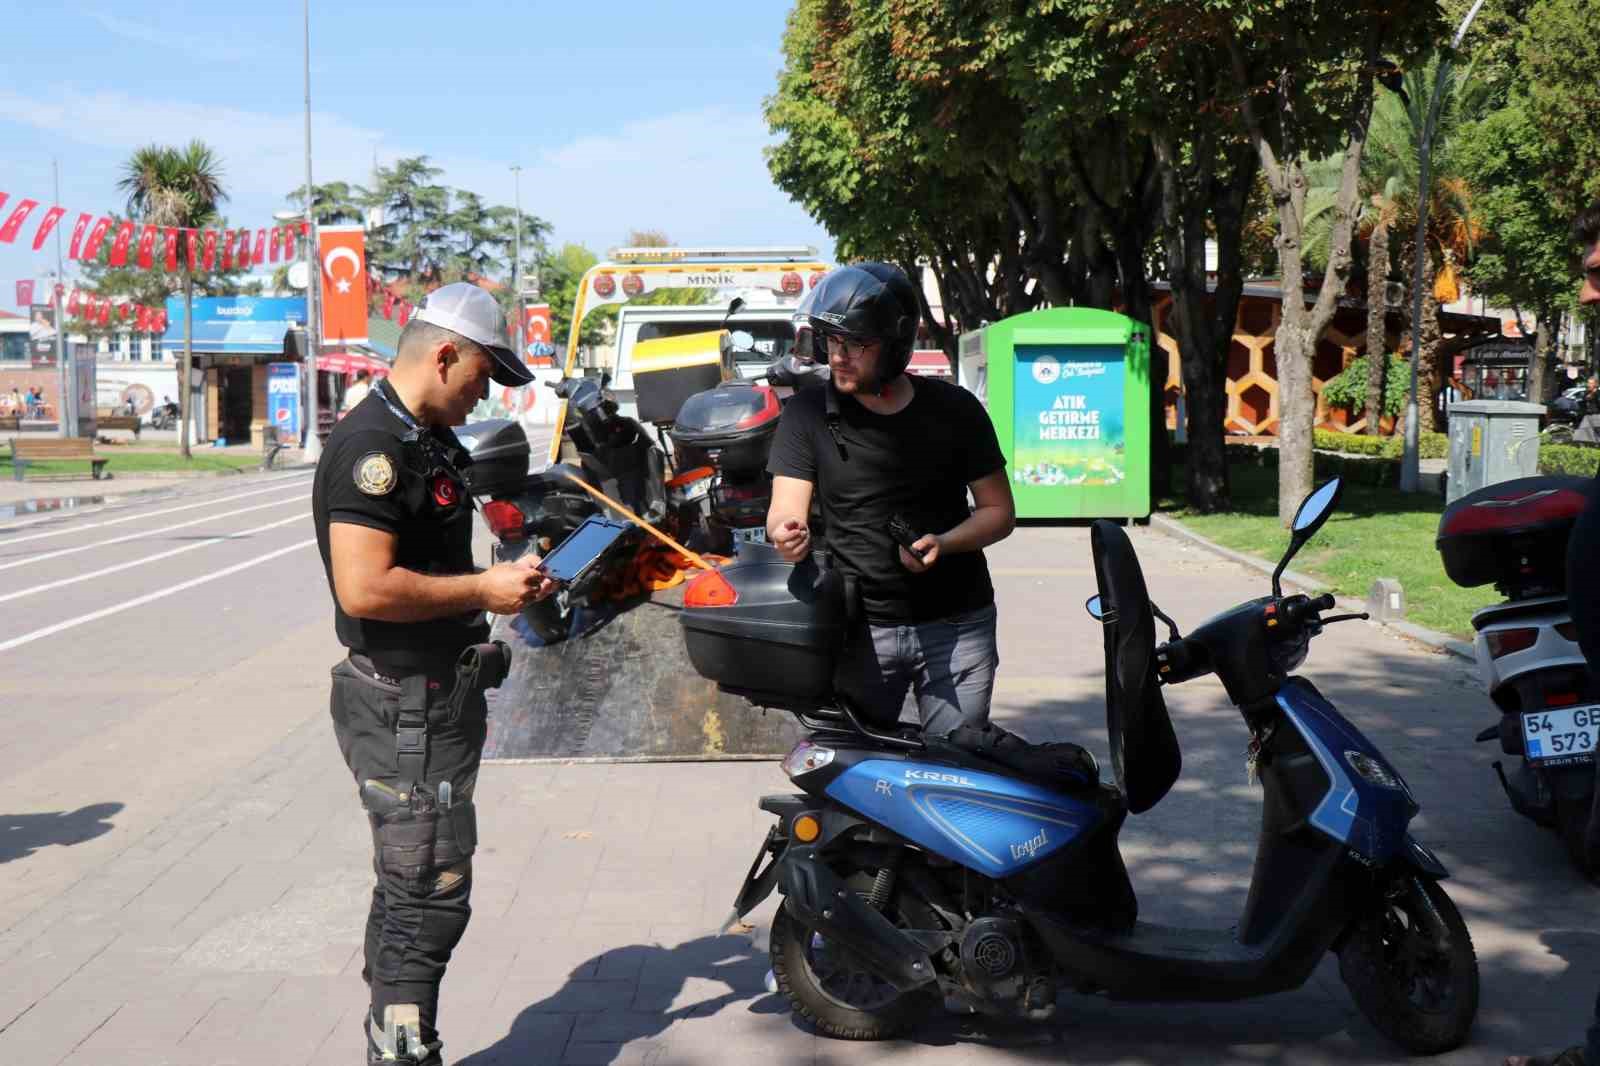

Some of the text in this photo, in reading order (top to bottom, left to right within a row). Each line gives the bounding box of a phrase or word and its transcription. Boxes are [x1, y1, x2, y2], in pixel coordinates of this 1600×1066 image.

[1053, 394, 1086, 410] ATIK
[1526, 714, 1553, 733] 54
[1551, 731, 1591, 752] 573
[1009, 827, 1049, 861] Loyal
